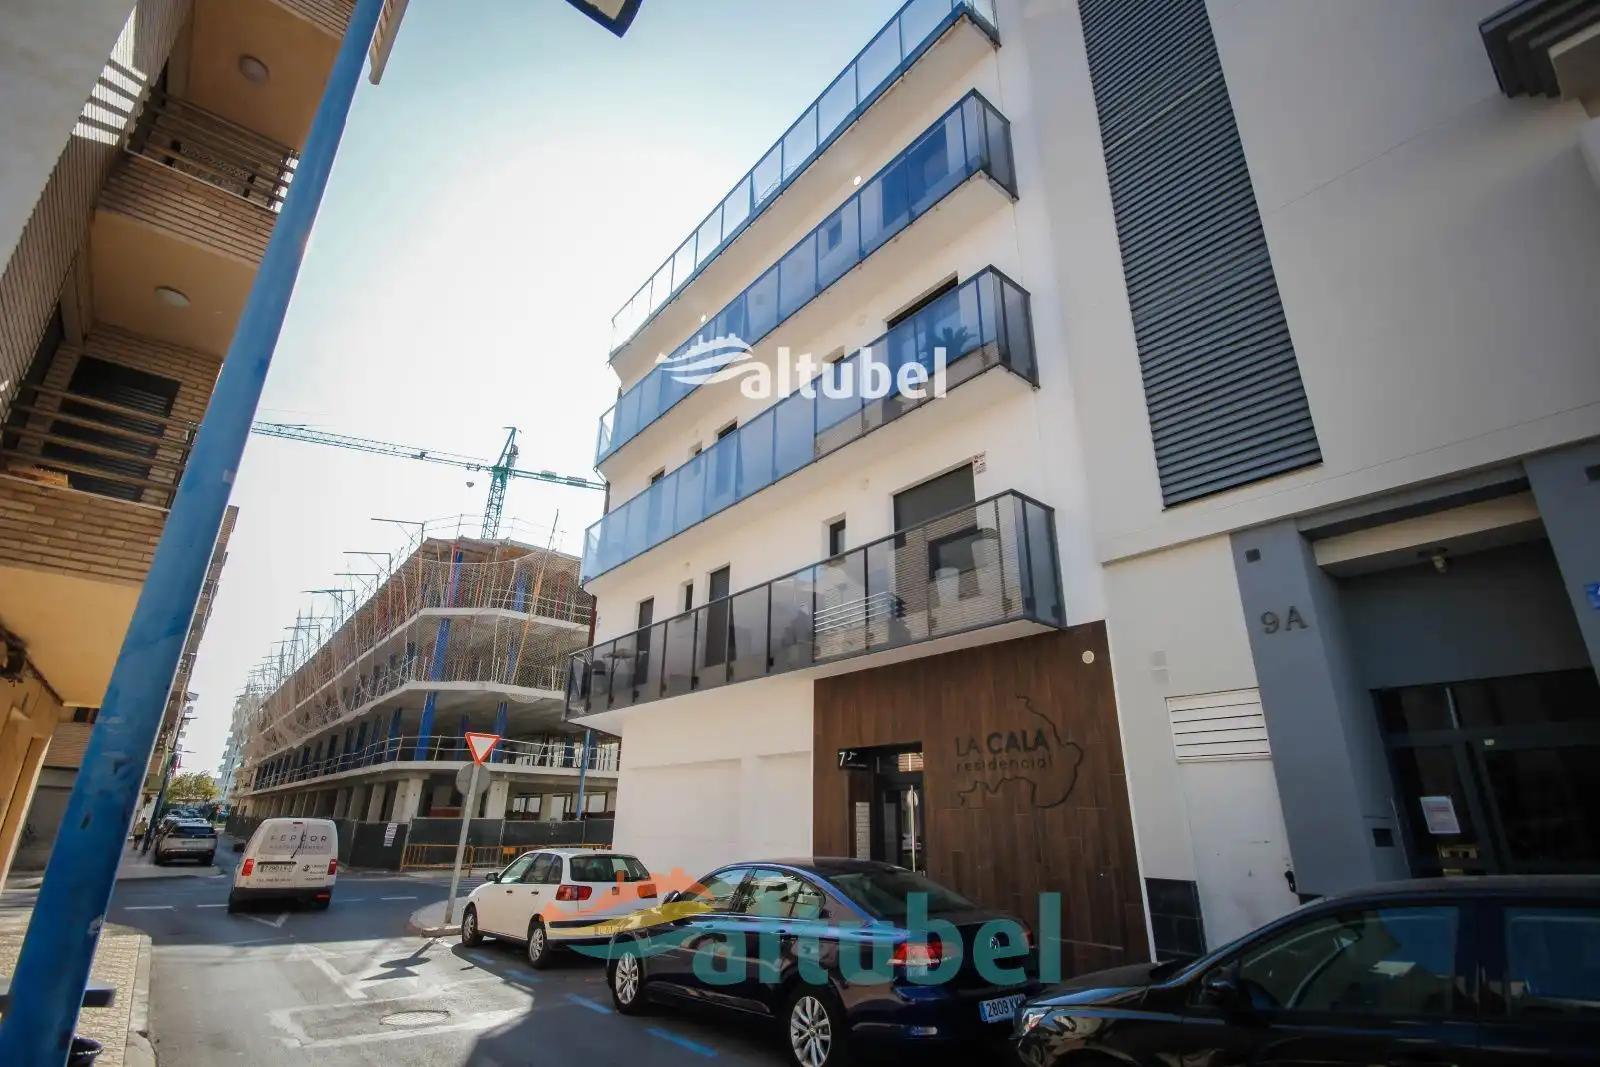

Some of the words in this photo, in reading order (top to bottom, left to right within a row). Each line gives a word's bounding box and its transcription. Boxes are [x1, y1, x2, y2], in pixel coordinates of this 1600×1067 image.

[1260, 605, 1308, 634] 9A
[956, 734, 981, 757] LA
[986, 728, 1051, 755] CALA
[956, 755, 1053, 773] residencial
[986, 1000, 1009, 1018] 2809
